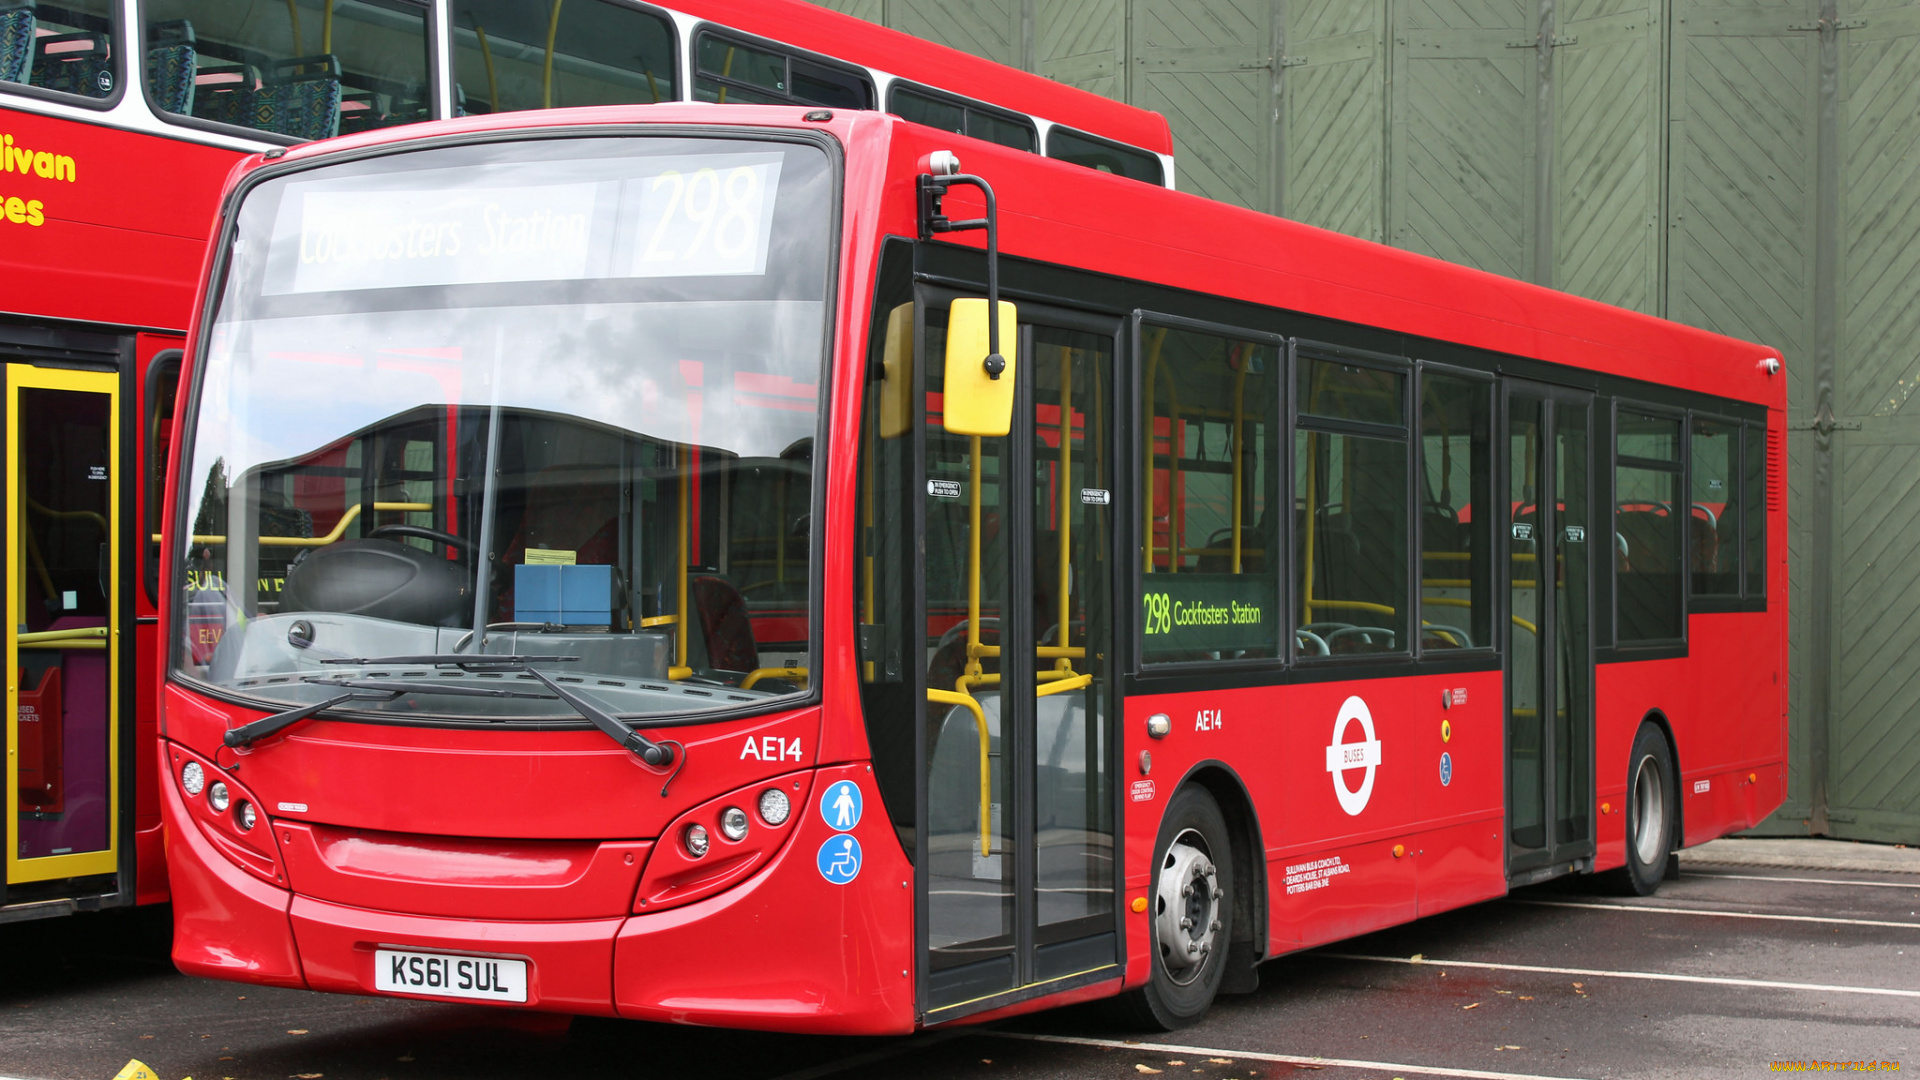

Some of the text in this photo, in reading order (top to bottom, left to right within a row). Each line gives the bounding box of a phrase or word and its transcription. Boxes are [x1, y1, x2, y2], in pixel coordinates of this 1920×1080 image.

[0, 195, 45, 227] es
[641, 165, 759, 263] 298
[478, 202, 588, 256] Station
[1143, 592, 1171, 635] 298
[1174, 599, 1261, 626] Cockfosters Station
[1195, 709, 1222, 732] AE14
[739, 735, 803, 762] AE14
[1343, 748, 1364, 763] BUSES
[1286, 862, 1306, 875] SULLIVAN
[391, 955, 509, 993] KS61 SUL
